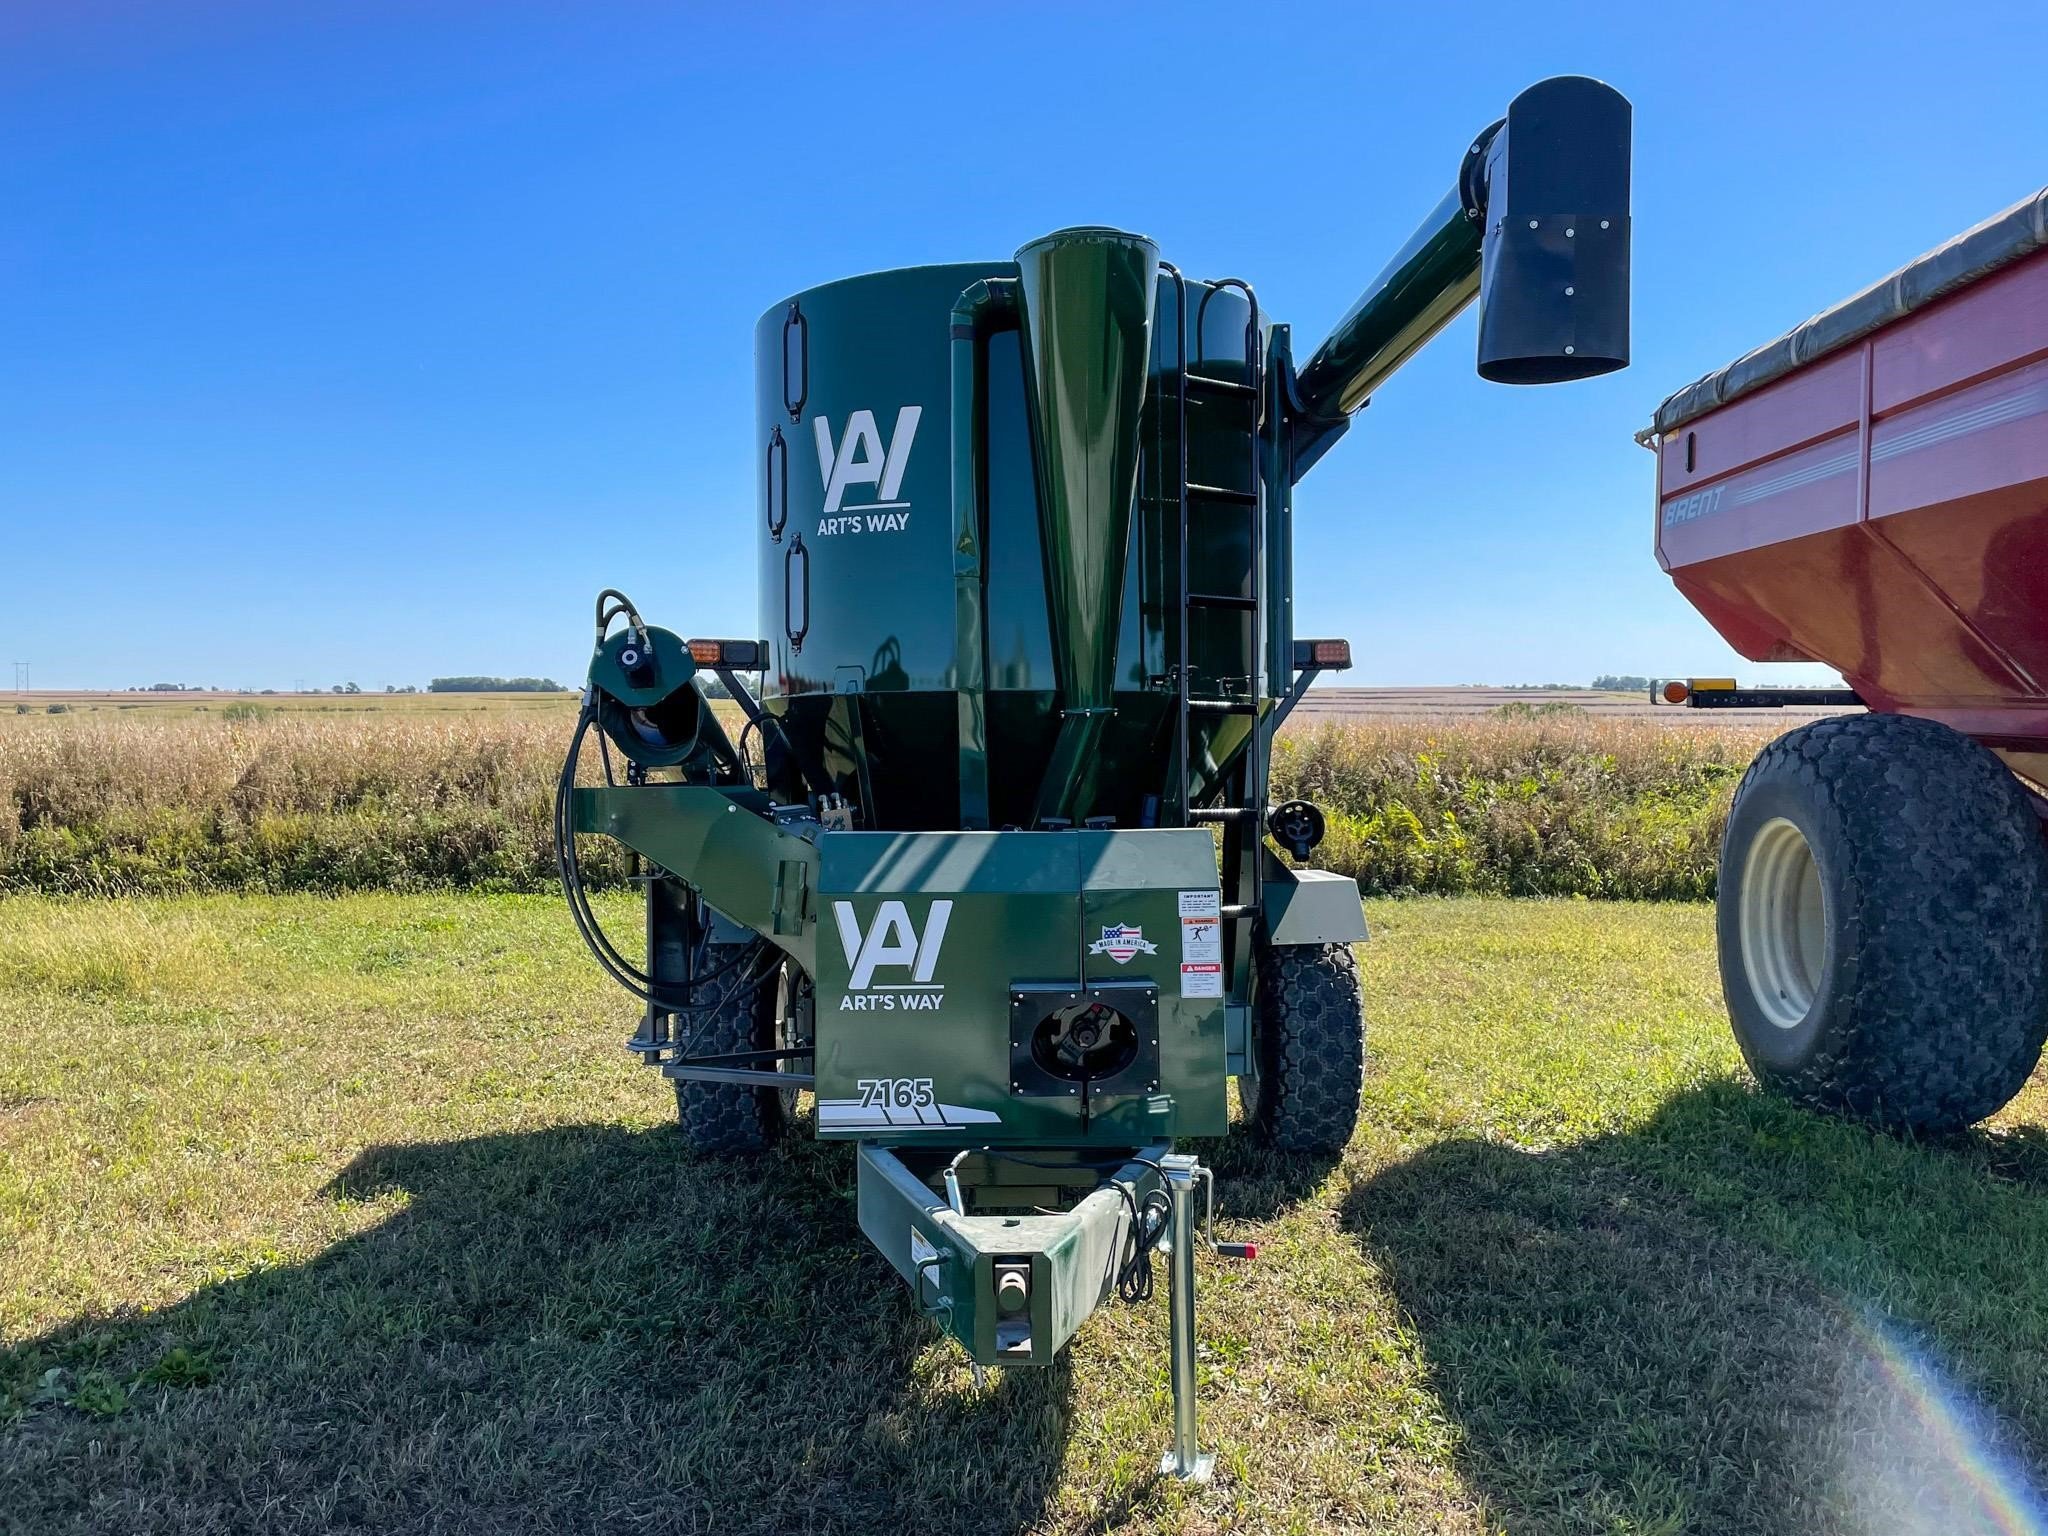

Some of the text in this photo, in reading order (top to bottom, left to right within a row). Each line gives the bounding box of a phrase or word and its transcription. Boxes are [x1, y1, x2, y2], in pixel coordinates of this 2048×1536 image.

[1664, 485, 1726, 526] BRENT
[816, 512, 910, 536] ART'S WAY
[1098, 940, 1114, 948] MADE
[1122, 938, 1146, 949] AMERICA
[839, 994, 944, 1011] ART'S WAY
[857, 1077, 934, 1109] 7165
